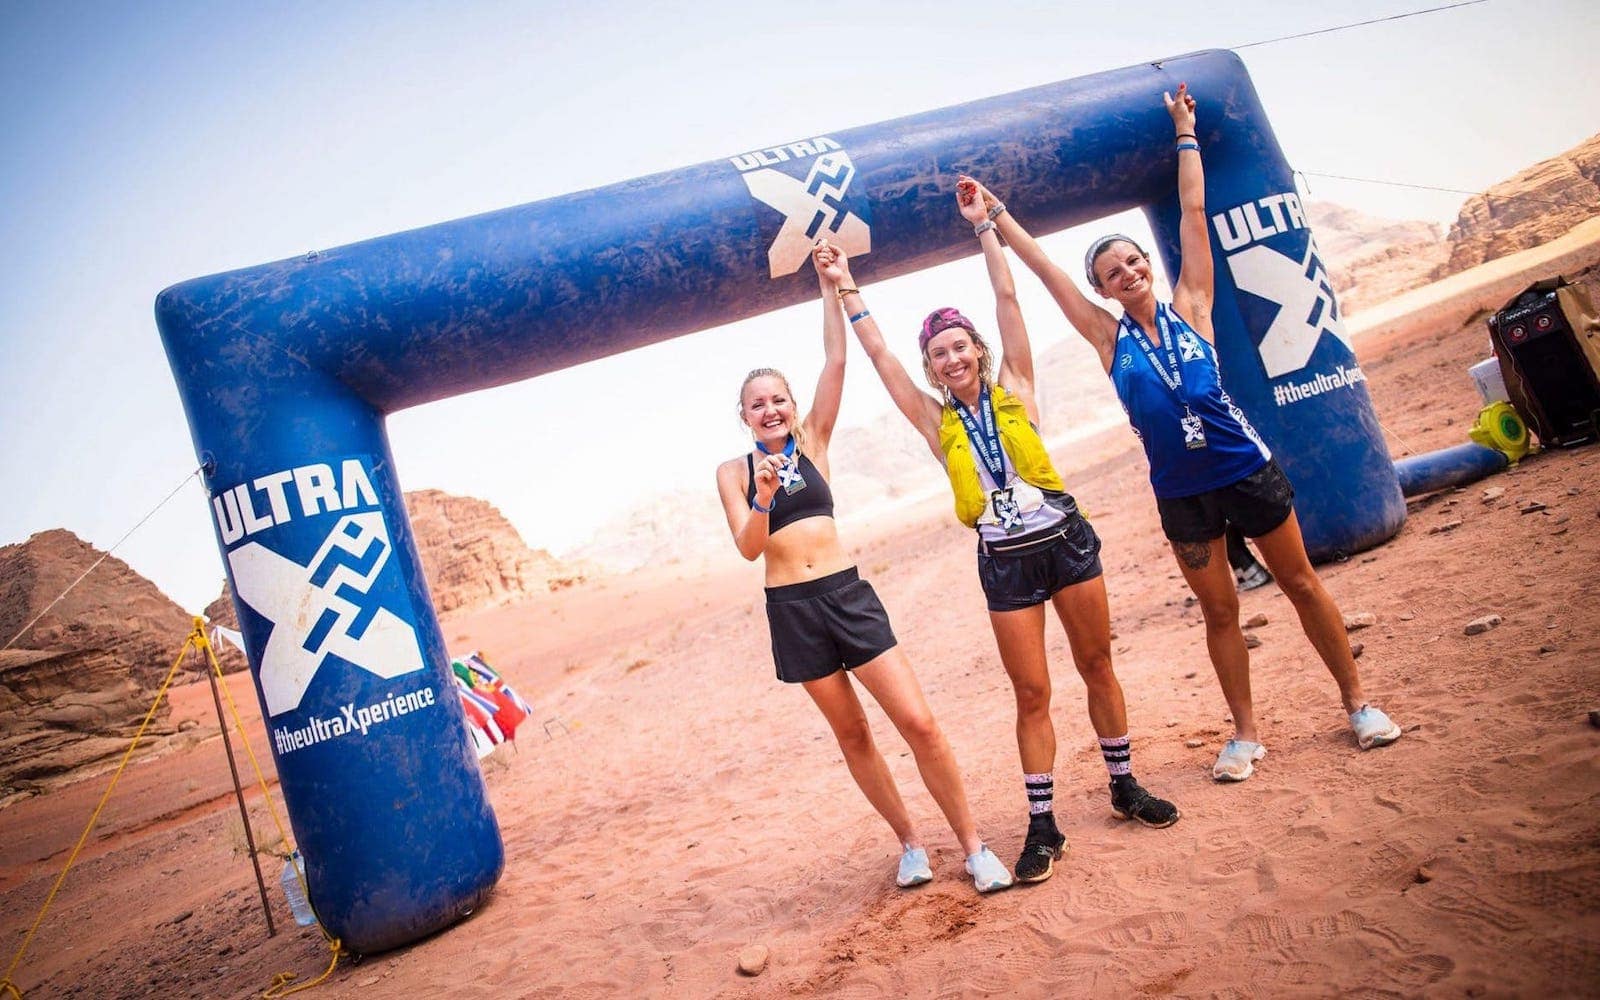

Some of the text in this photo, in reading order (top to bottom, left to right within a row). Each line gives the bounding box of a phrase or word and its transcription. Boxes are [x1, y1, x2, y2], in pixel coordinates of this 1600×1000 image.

[729, 137, 842, 171] ULTRA
[1212, 192, 1307, 251] ULTR
[213, 459, 380, 546] ULTRA
[274, 687, 435, 755] #theultraXperience
